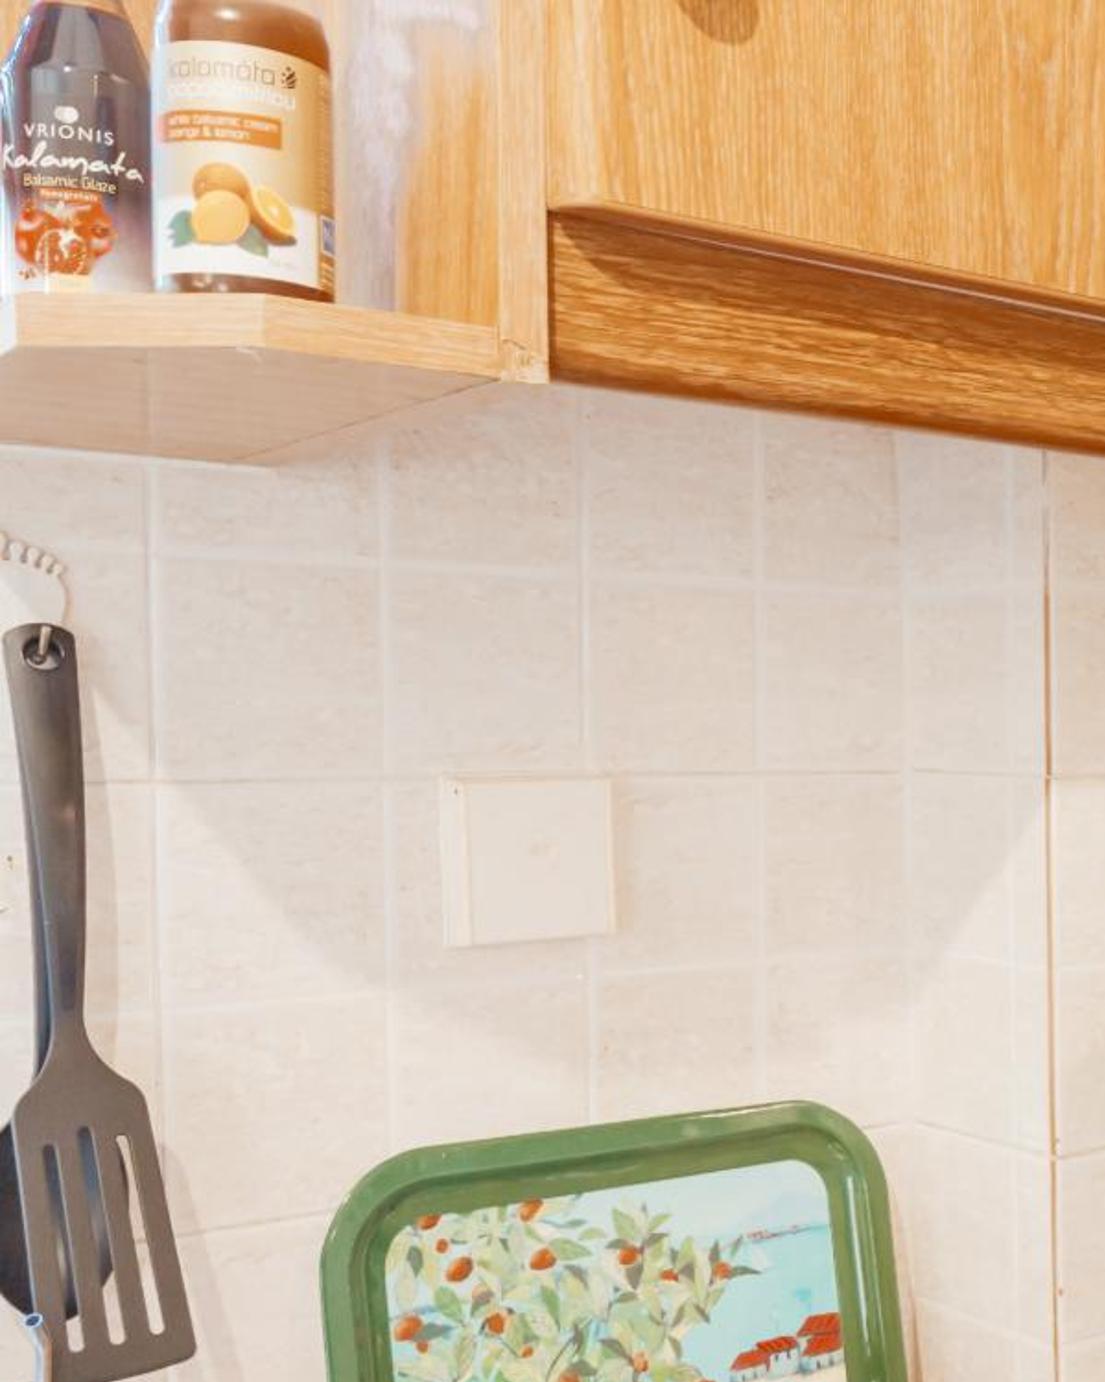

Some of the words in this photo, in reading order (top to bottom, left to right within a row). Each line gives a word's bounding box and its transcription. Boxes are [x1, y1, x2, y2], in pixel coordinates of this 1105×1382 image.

[23, 122, 115, 146] VRIONIS
[2, 140, 144, 184] Kalamata
[23, 172, 79, 188] Balsamic
[81, 176, 117, 194] Glaze
